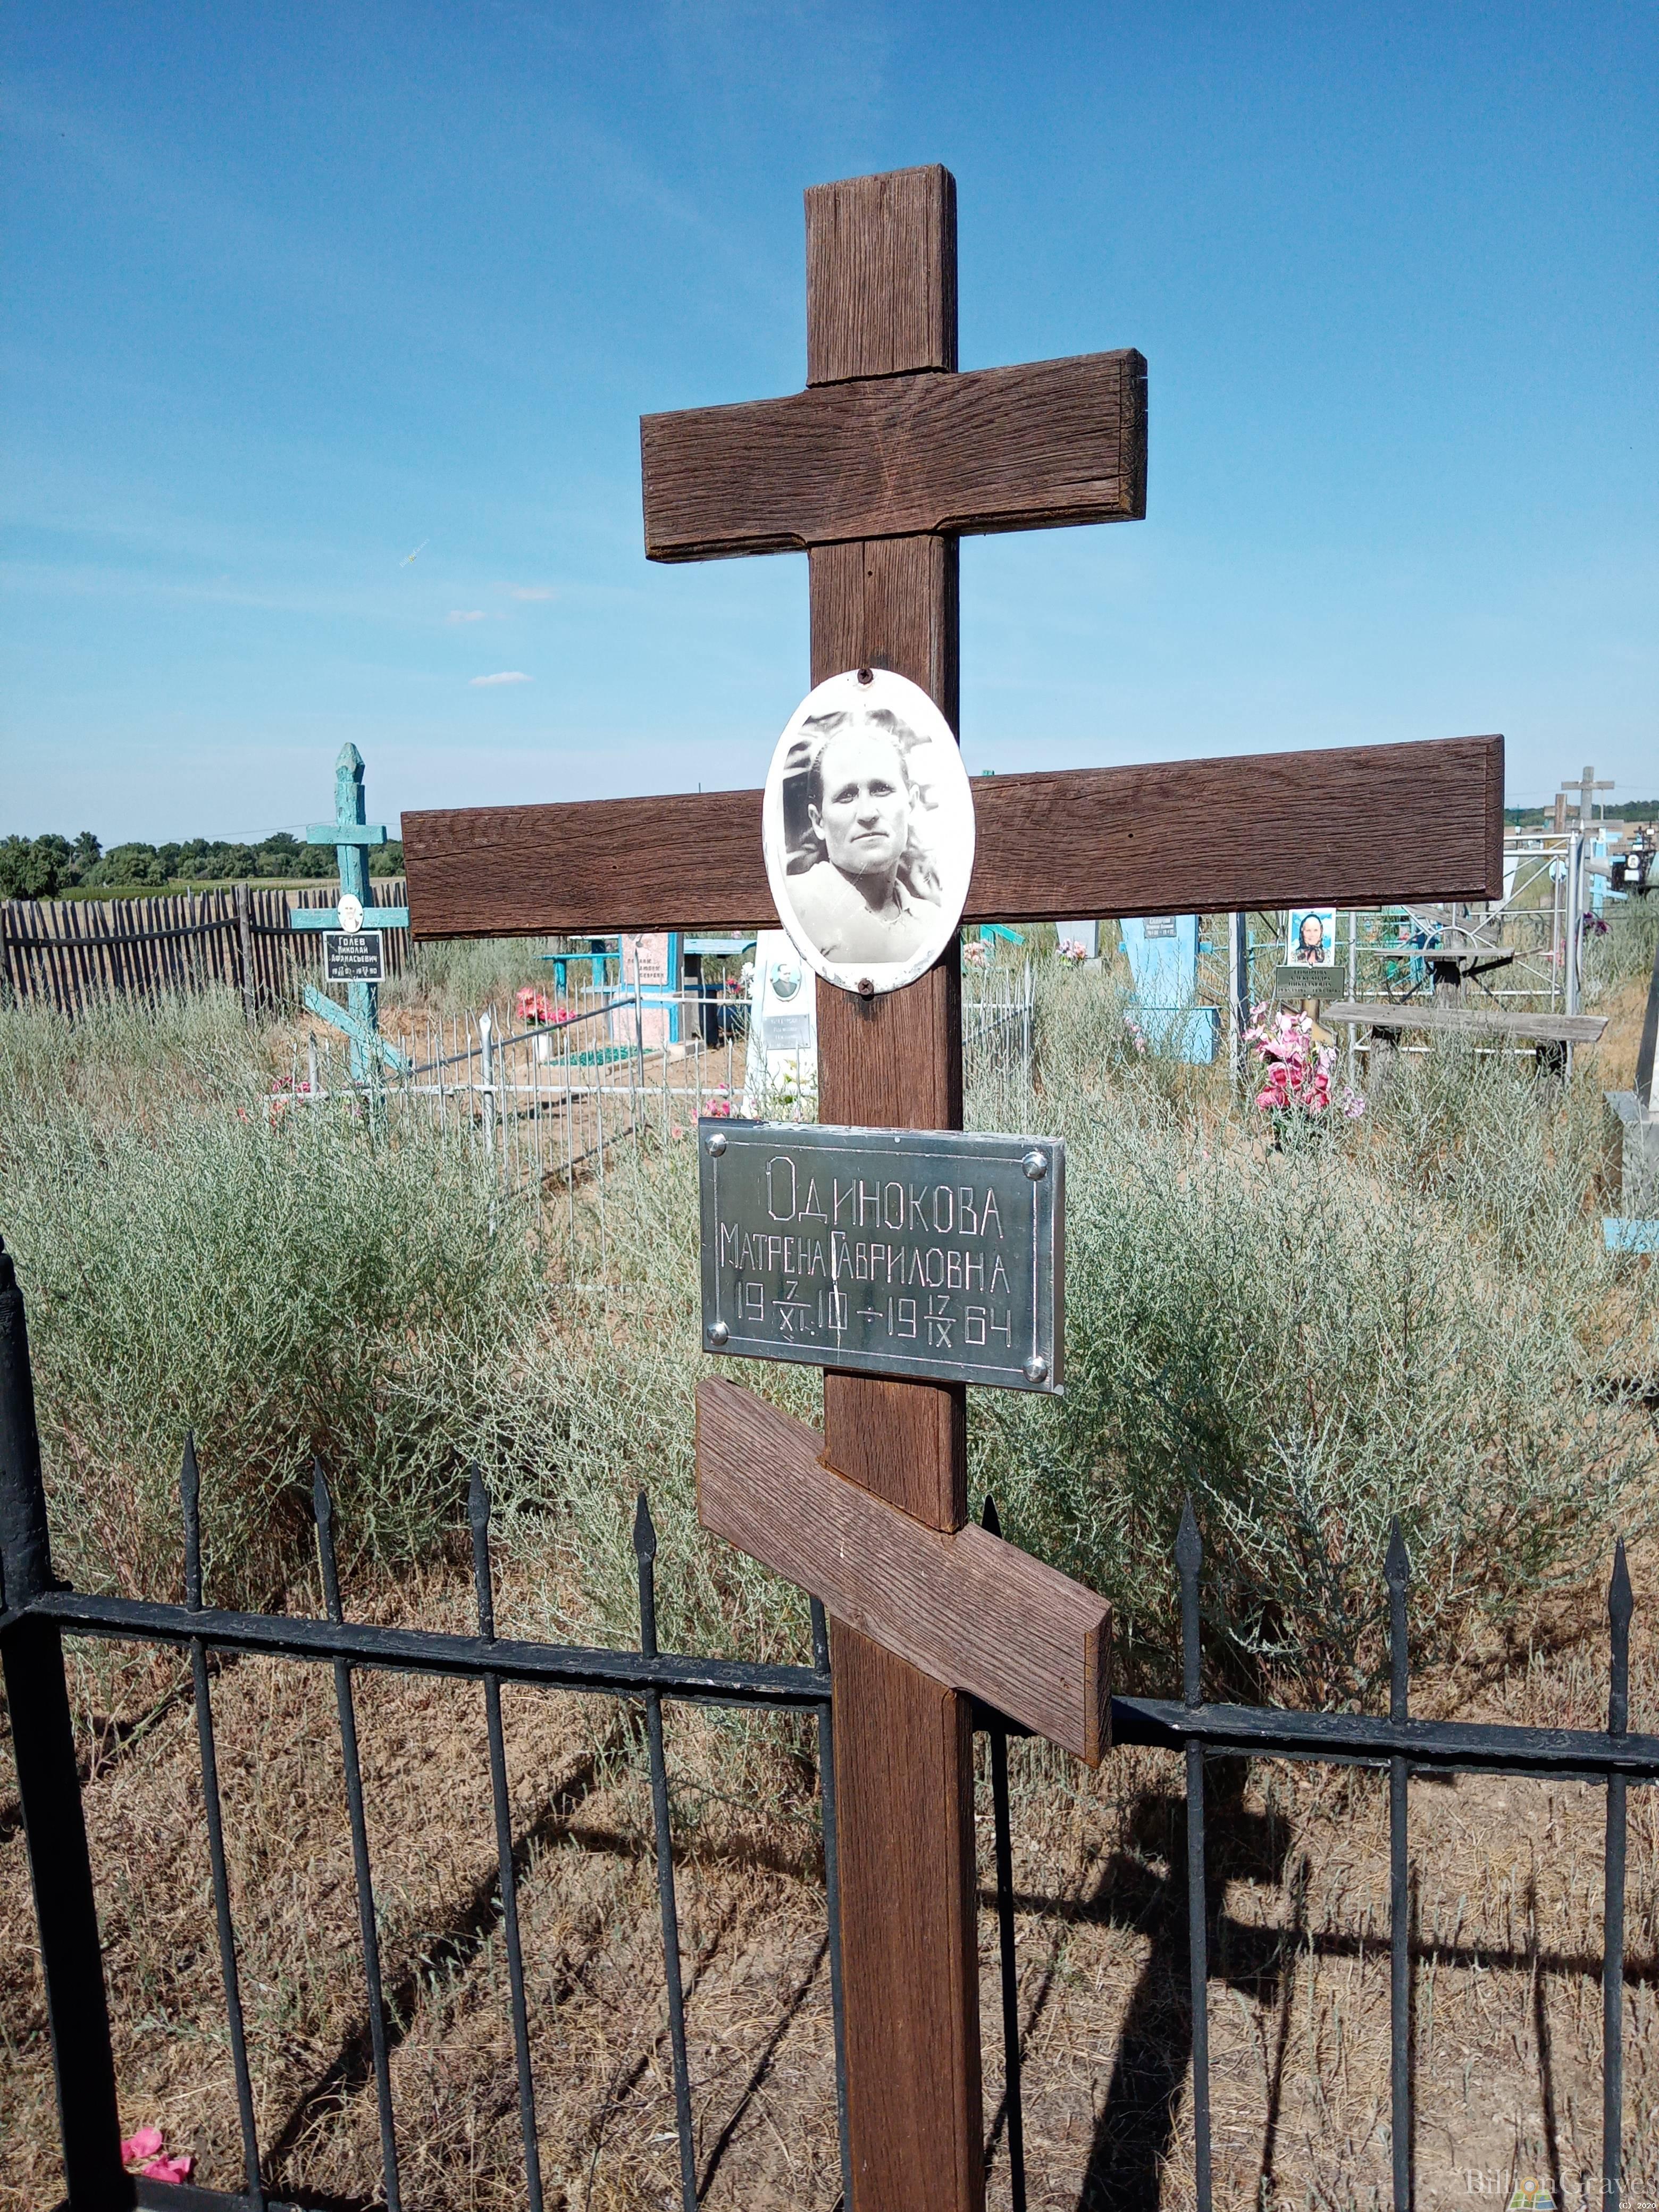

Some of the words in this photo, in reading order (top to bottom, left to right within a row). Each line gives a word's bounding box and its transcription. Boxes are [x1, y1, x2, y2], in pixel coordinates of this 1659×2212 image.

[338, 936, 366, 946] ГОЛЕВ
[766, 1155, 1004, 1239] ОДИНОКОВА
[720, 1221, 826, 1277] МАТРЕНА
[830, 1230, 1011, 1294] ГАВРИЛОВНА
[964, 1305, 1012, 1348] 64
